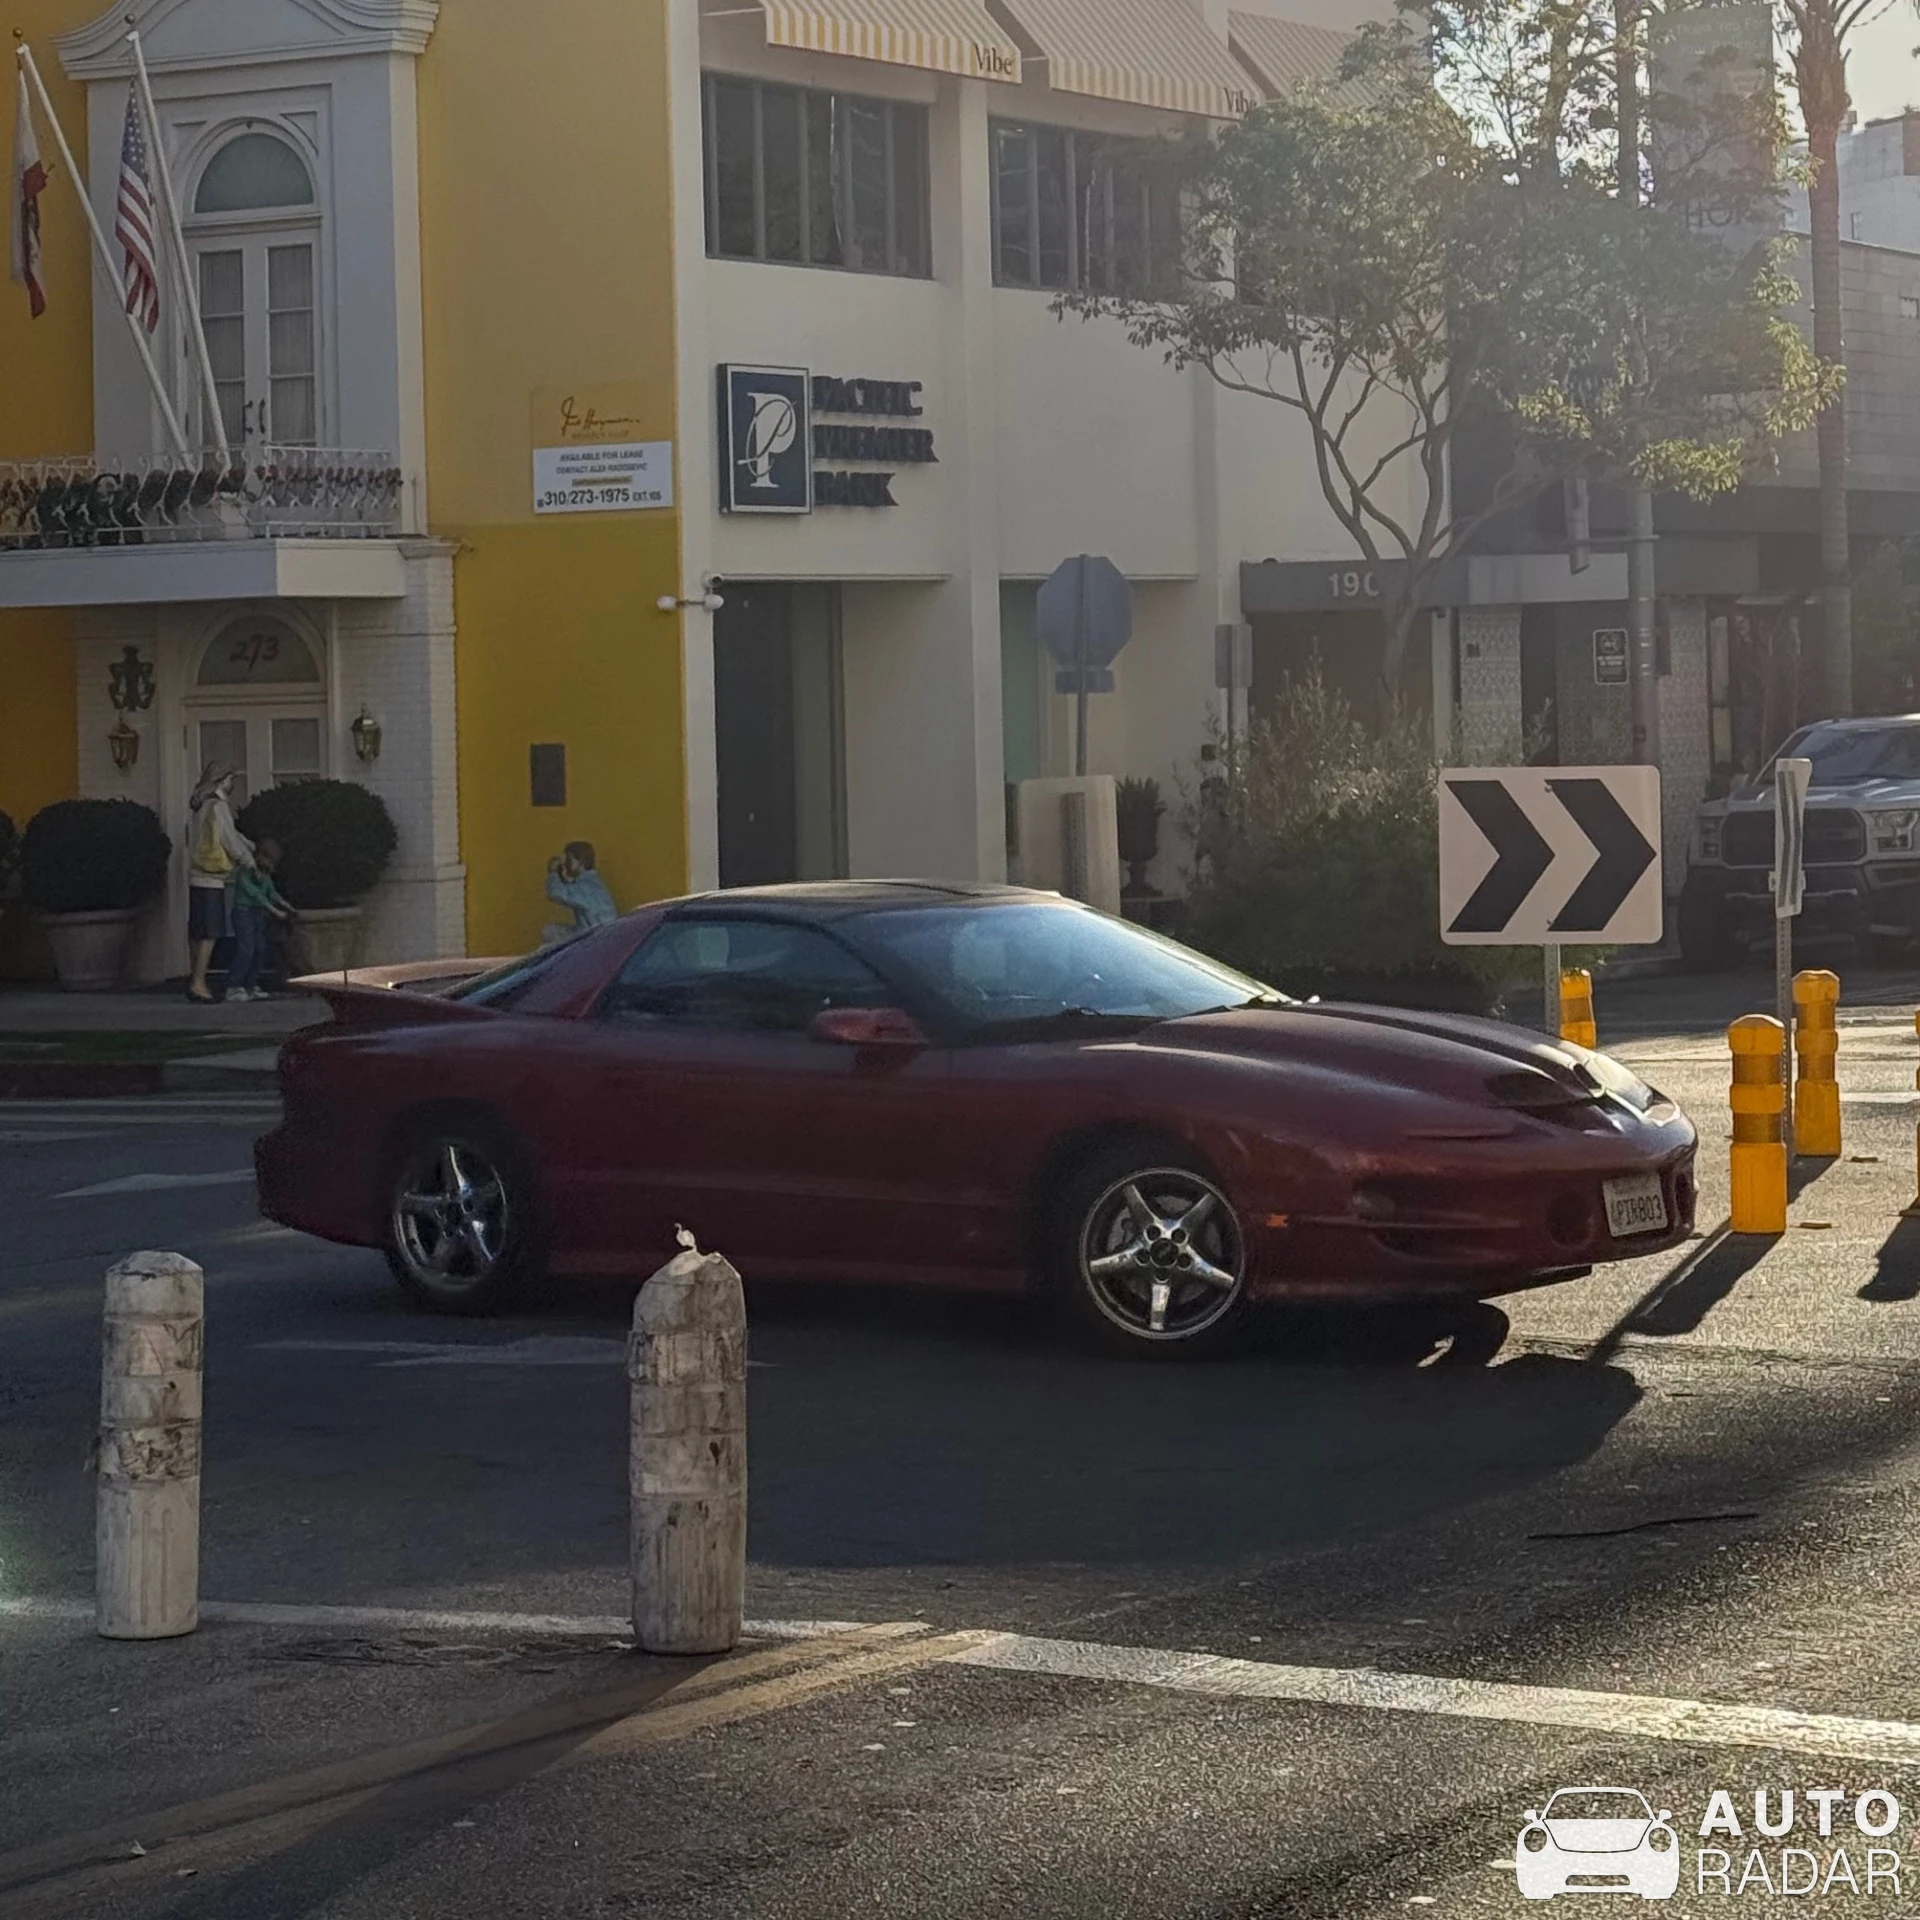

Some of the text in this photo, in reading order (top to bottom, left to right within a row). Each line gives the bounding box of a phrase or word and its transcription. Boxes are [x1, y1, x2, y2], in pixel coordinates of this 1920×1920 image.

[974, 43, 1013, 75] Vibe
[811, 375, 923, 416] PACIFIC
[560, 449, 644, 462] AVAILABLE FOR LEASE
[228, 633, 280, 672] 273
